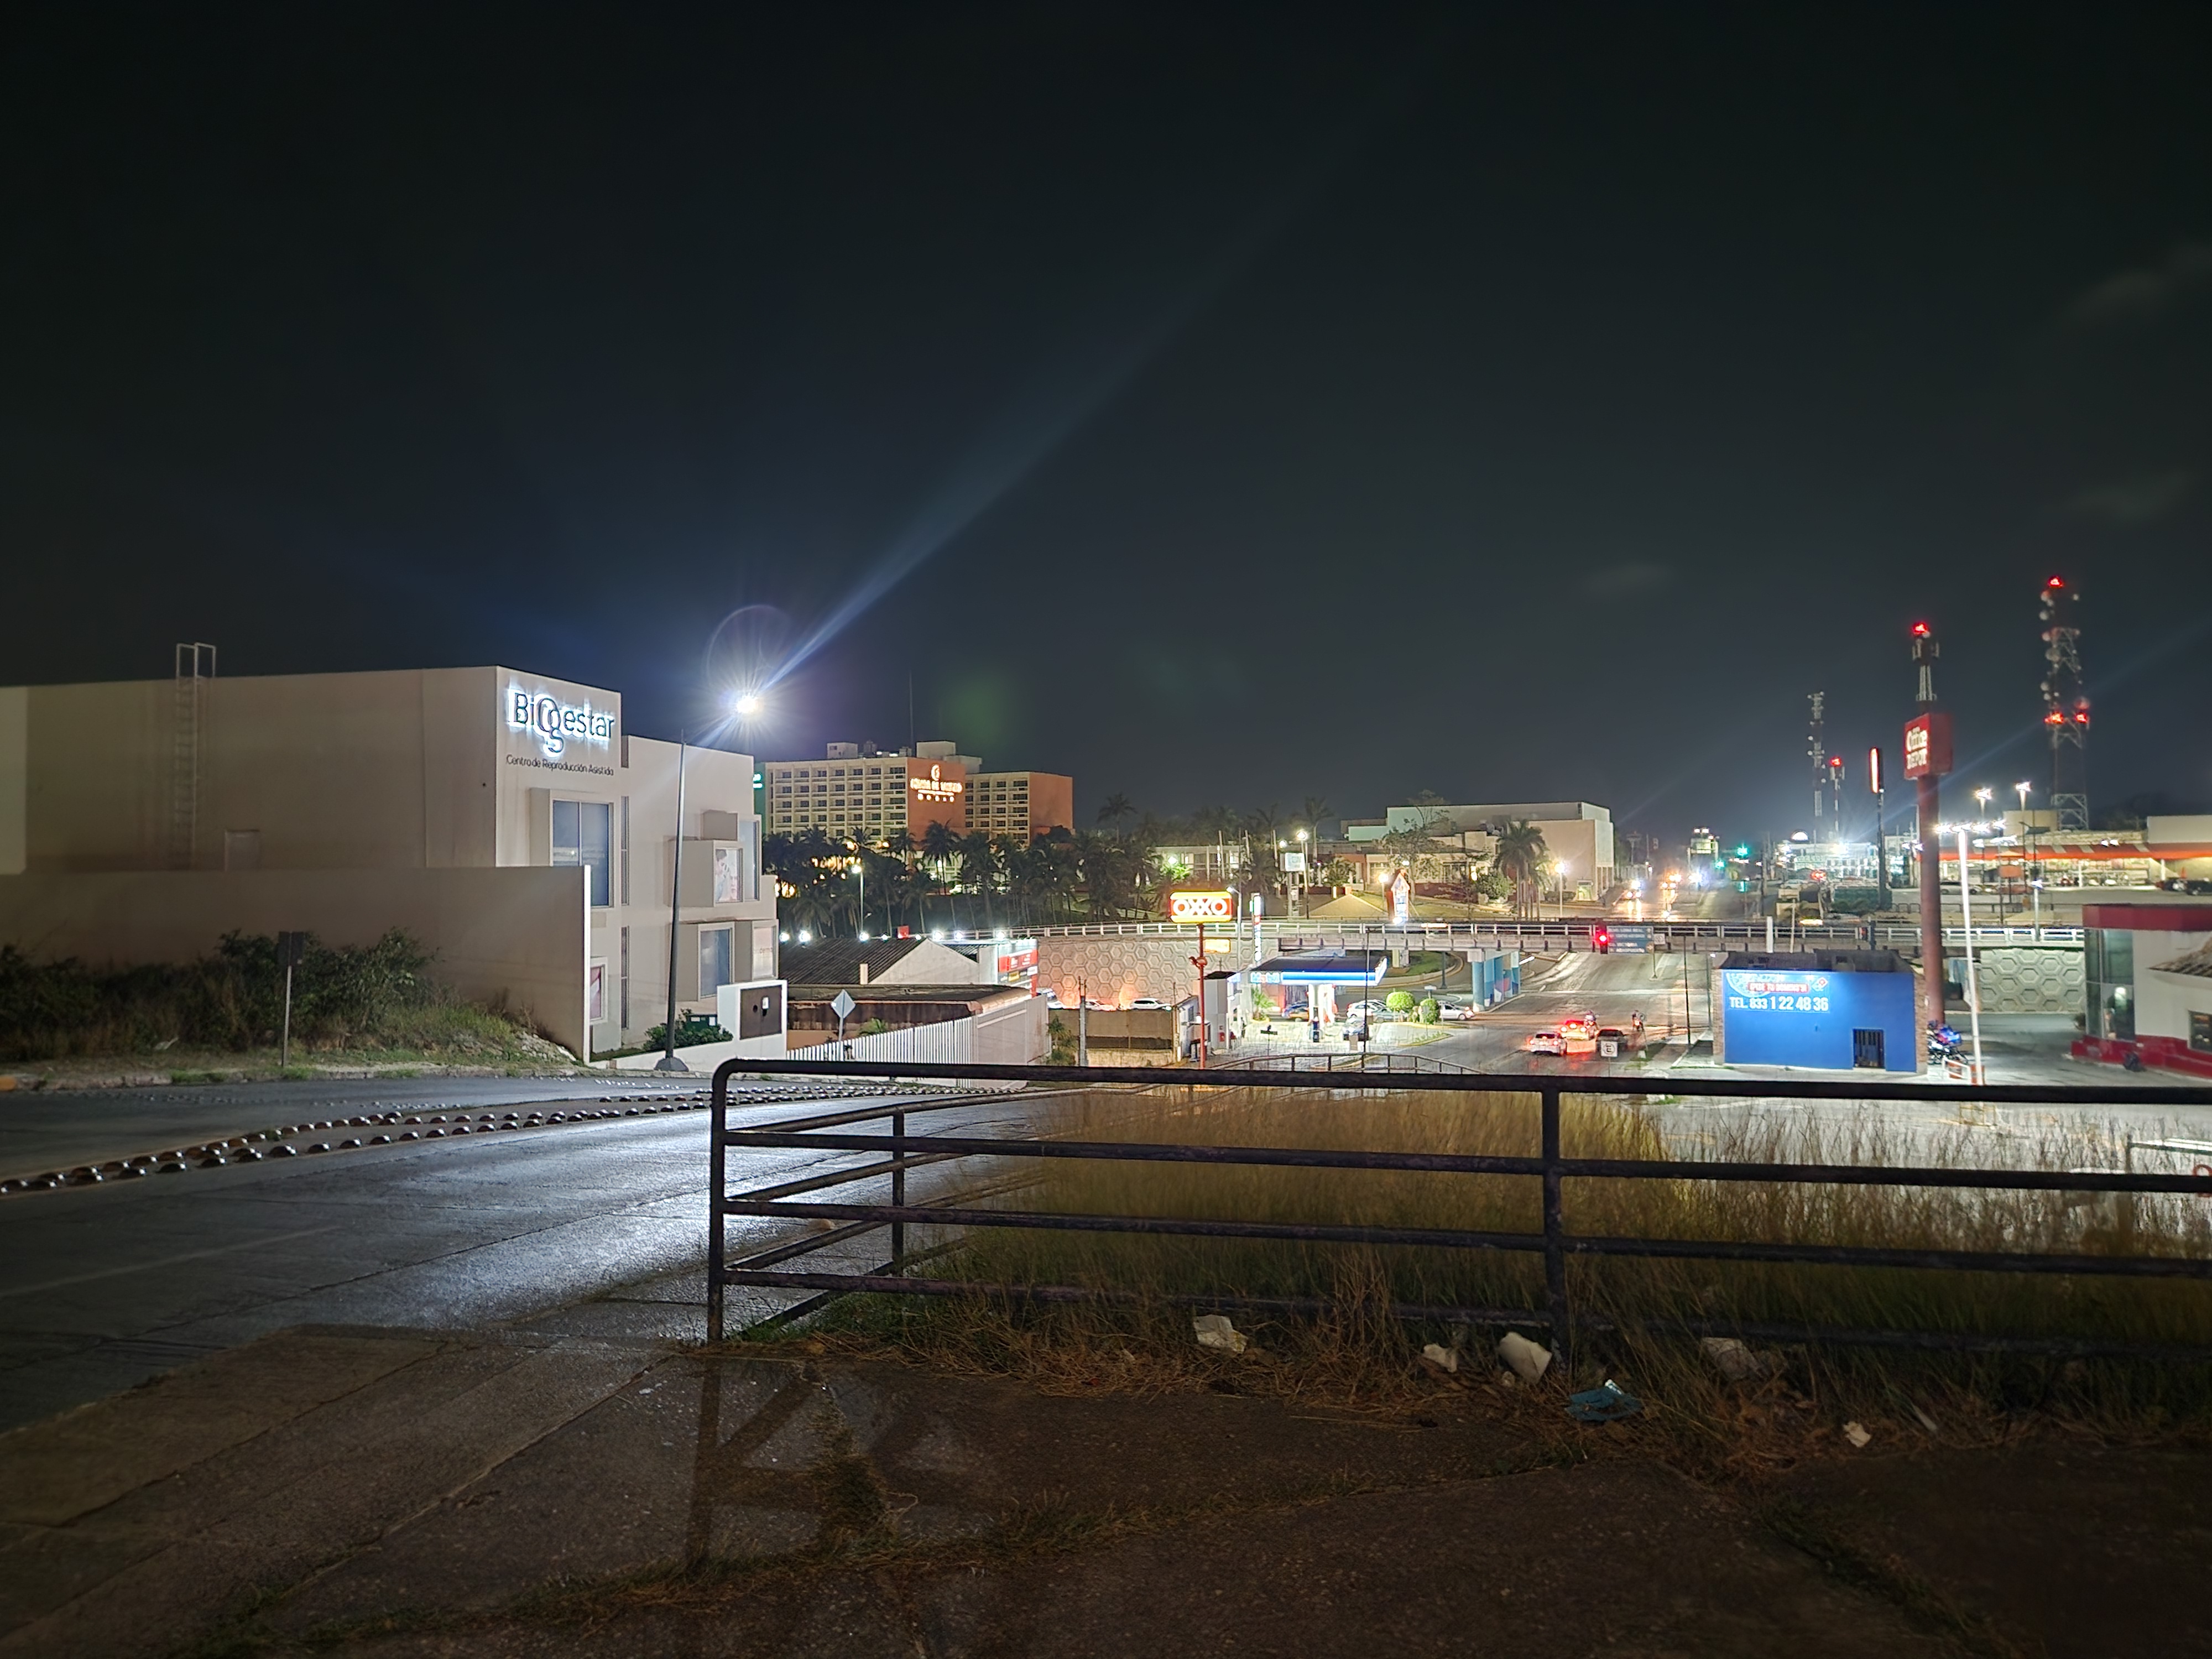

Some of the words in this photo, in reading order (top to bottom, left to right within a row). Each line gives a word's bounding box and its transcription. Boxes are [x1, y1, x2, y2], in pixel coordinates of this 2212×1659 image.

[506, 754, 531, 766] Centro
[542, 759, 587, 772] Reproducción
[588, 764, 614, 775] Asistida
[1173, 899, 1228, 916] OXXO
[1729, 997, 1748, 1009] TEL.
[1749, 998, 1768, 1009] 833
[1770, 996, 1776, 1010] 1
[1778, 996, 1794, 1010] 22
[1796, 996, 1812, 1011] 48
[1813, 997, 1829, 1011] 36
